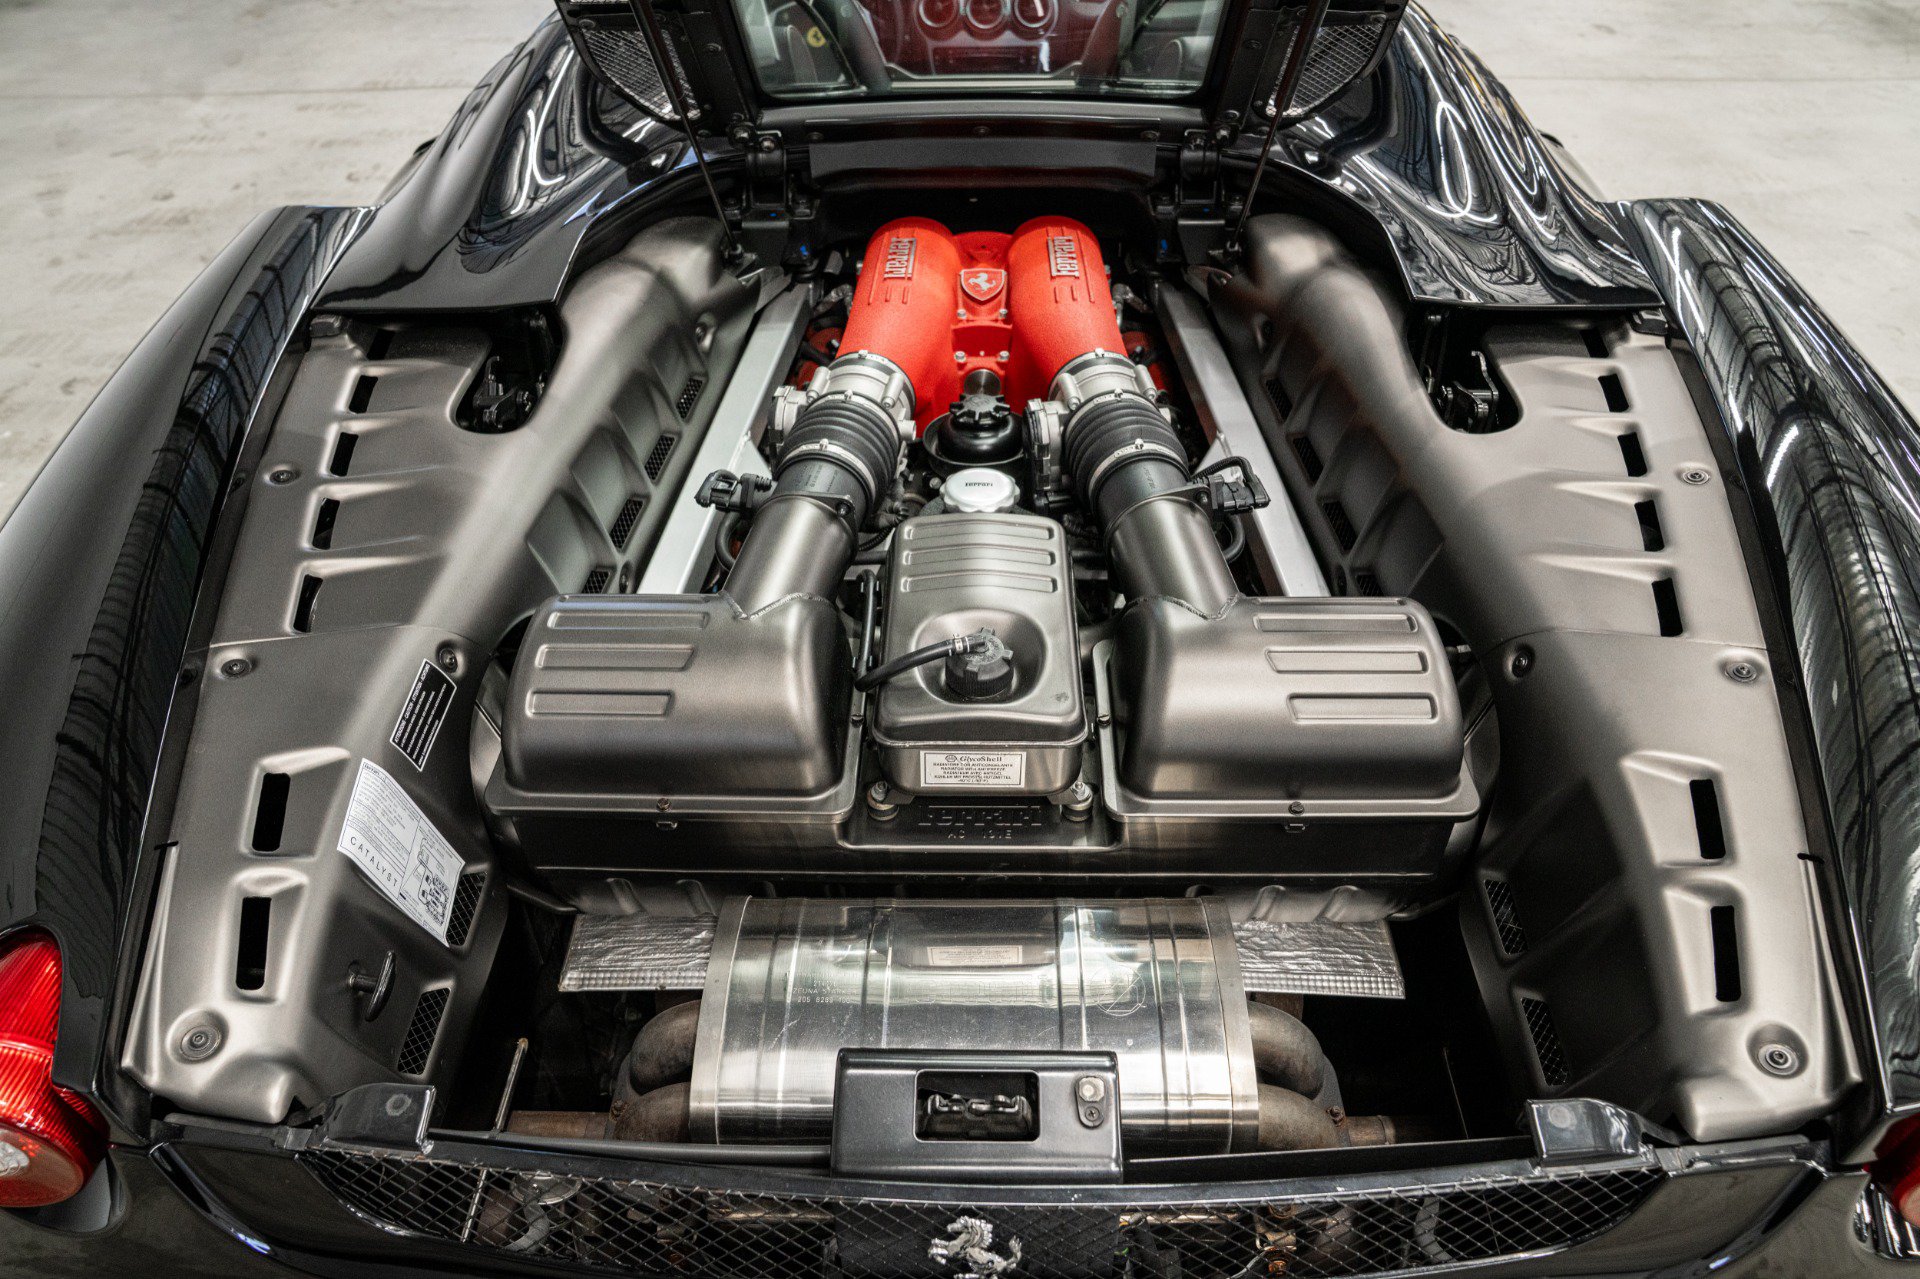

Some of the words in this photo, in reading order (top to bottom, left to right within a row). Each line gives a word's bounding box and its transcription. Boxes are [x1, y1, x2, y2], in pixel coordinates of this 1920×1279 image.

[884, 237, 916, 278] Ferrari
[1047, 235, 1079, 276] Ferrari
[959, 755, 1002, 763] GlycoShell
[350, 836, 398, 887] CATALYST
